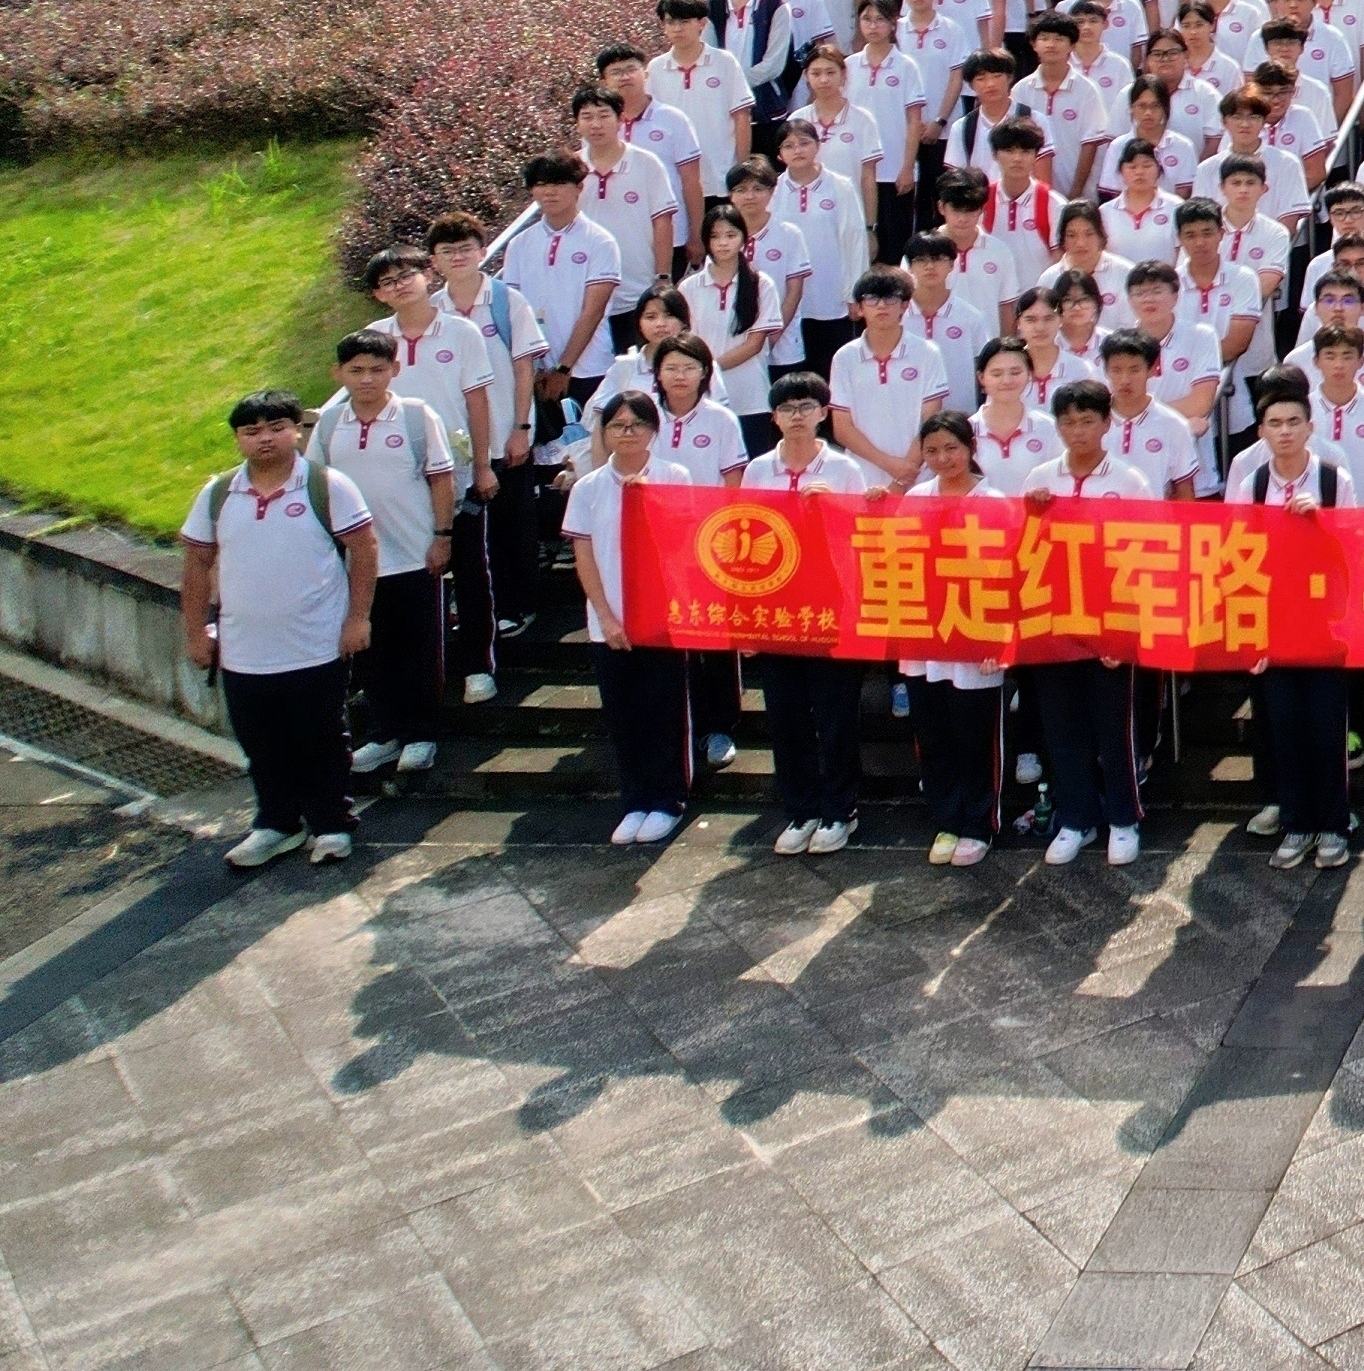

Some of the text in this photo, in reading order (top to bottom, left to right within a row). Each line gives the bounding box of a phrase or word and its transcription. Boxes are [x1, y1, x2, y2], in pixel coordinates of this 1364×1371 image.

[668, 599, 839, 633] 惠东综合实验学校
